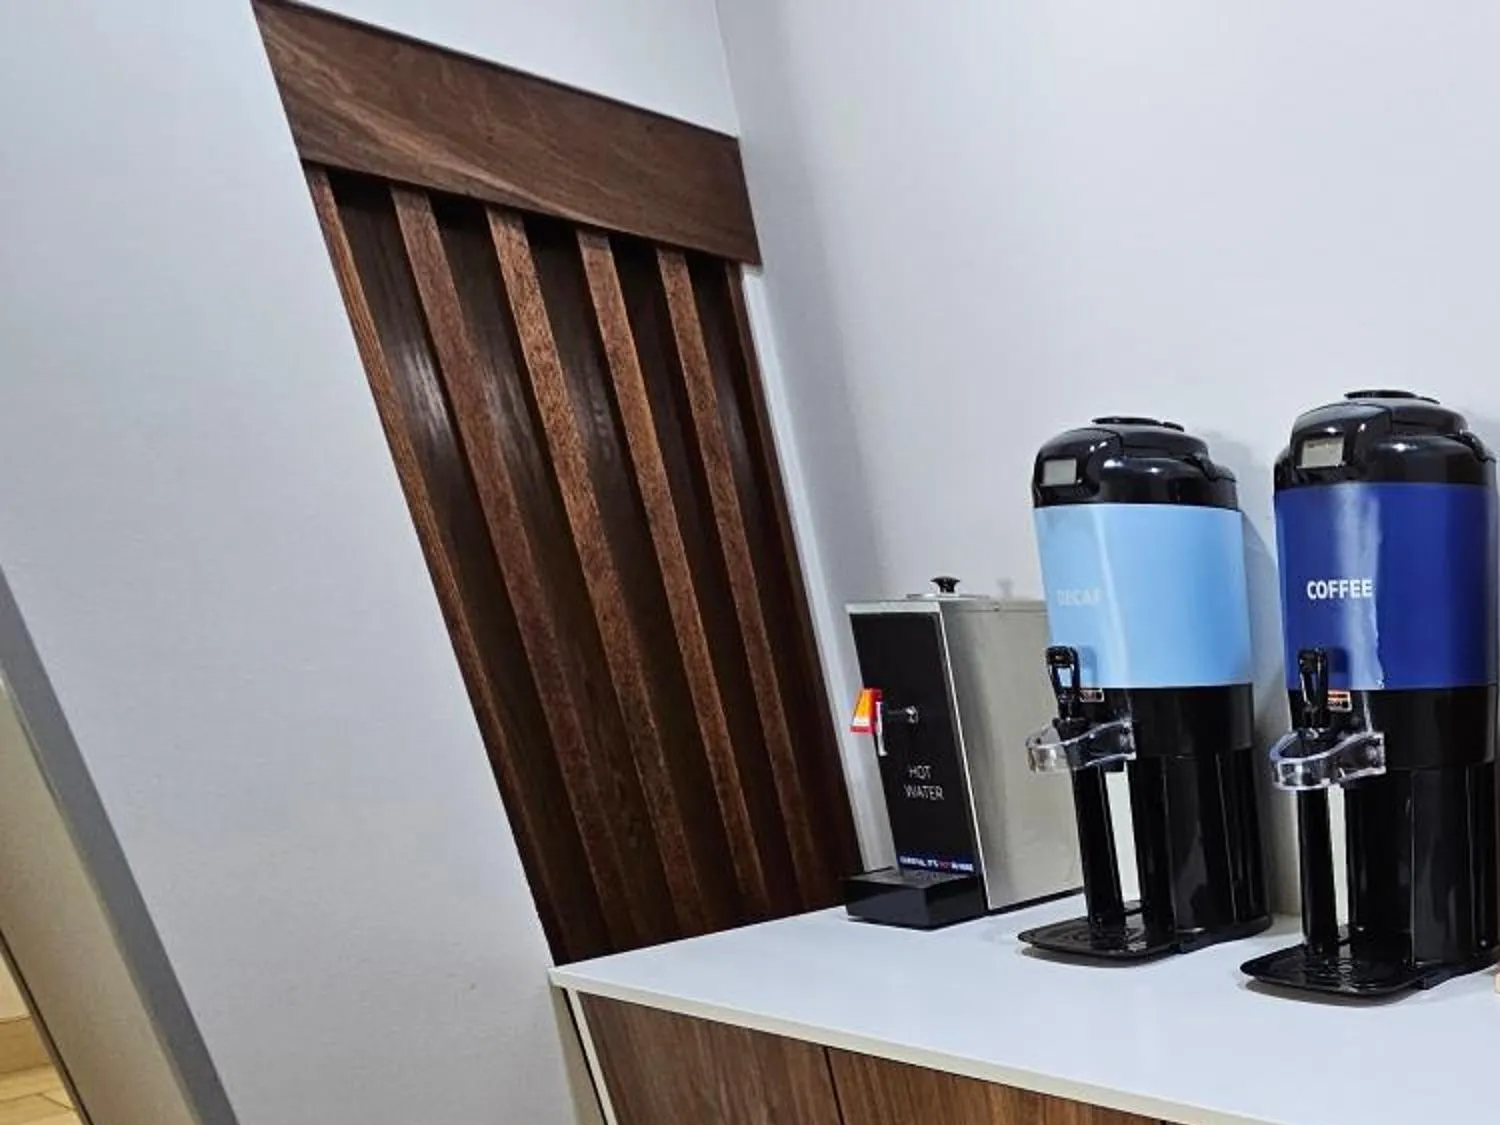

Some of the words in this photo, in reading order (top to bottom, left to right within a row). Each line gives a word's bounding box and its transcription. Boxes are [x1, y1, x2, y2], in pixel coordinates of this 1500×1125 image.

[1306, 578, 1373, 600] COFFEE
[908, 765, 931, 779] HOT
[903, 784, 944, 801] WATER
